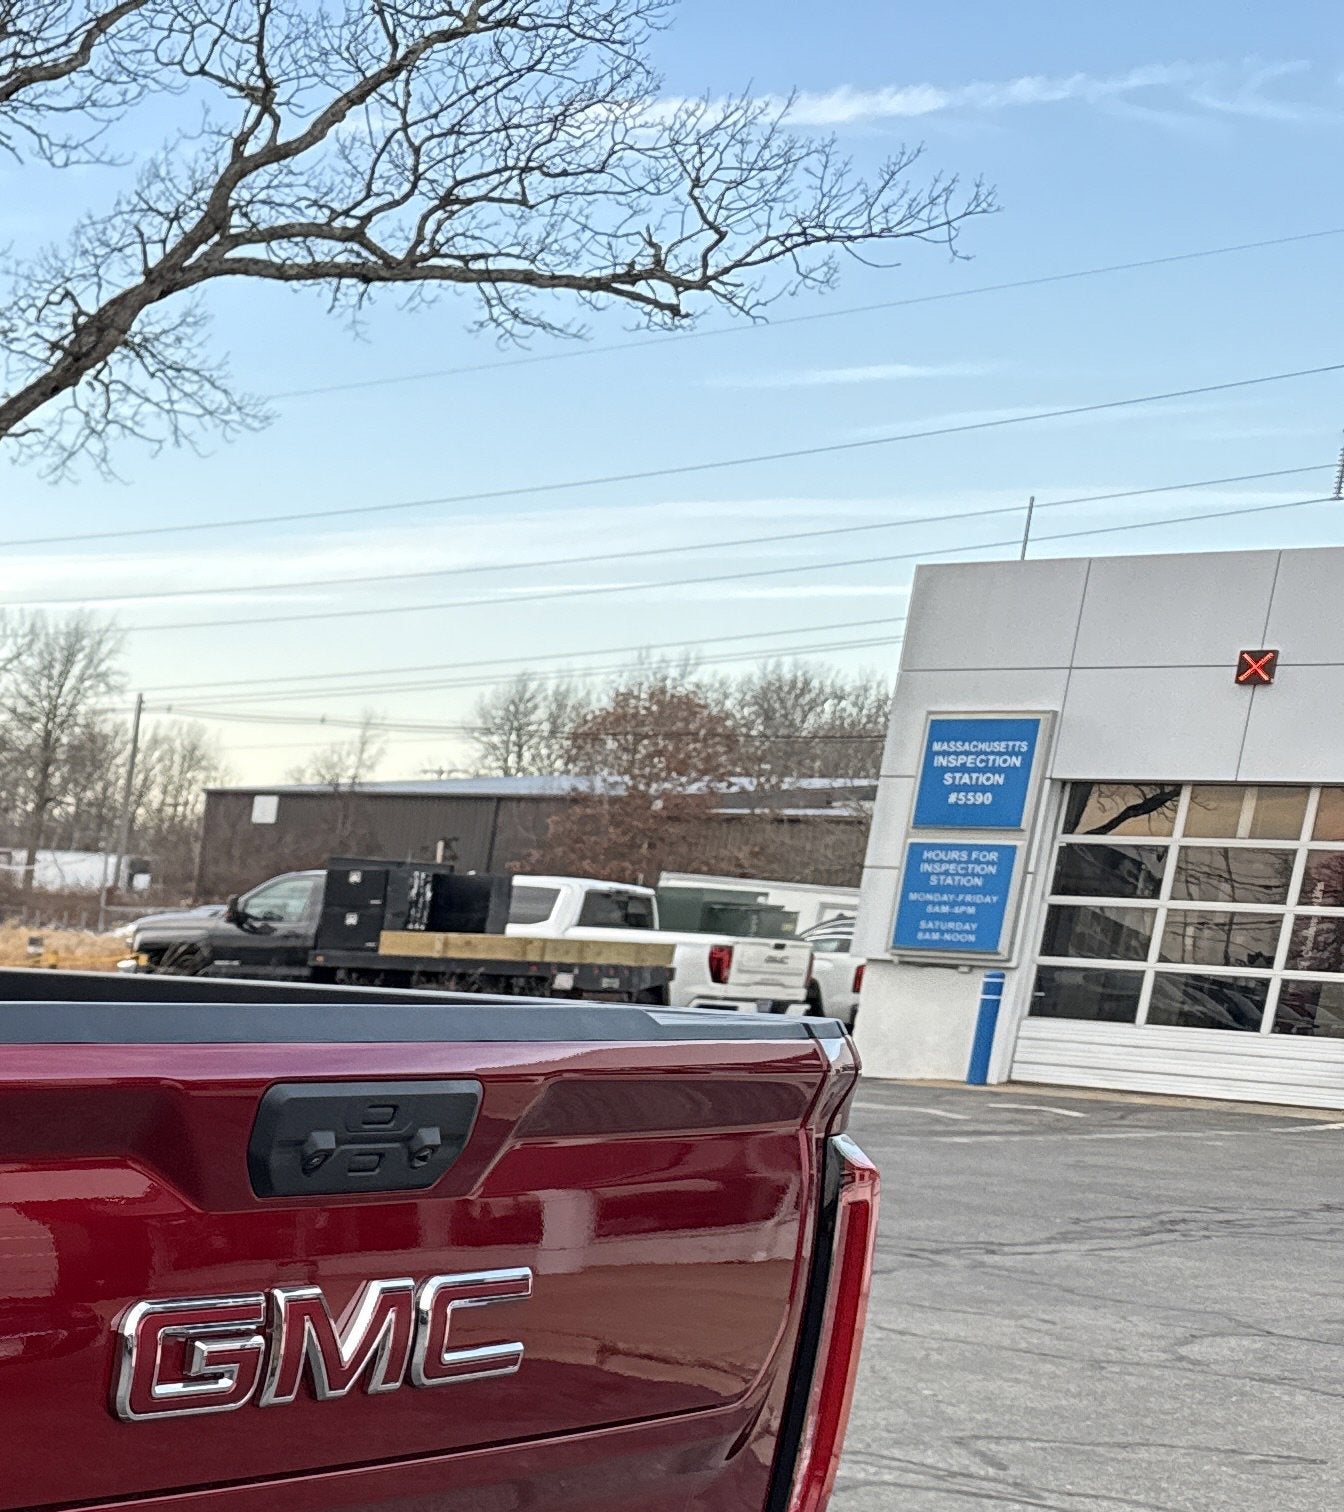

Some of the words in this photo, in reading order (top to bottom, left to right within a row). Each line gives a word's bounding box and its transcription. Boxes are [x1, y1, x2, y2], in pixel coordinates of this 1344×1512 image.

[932, 741, 1029, 752] MASSACHUSETTS
[933, 755, 1022, 767] INSPECTION
[943, 772, 1005, 785] STATION
[947, 792, 993, 805] #5590
[922, 850, 968, 861] HOURS
[971, 851, 999, 862] FOR
[920, 862, 998, 875] INSPECTION
[929, 875, 983, 887] STATION
[908, 892, 999, 903] MONDAY-FRIDAY
[919, 920, 978, 931] SATURDAY
[116, 1266, 534, 1423] GMC
